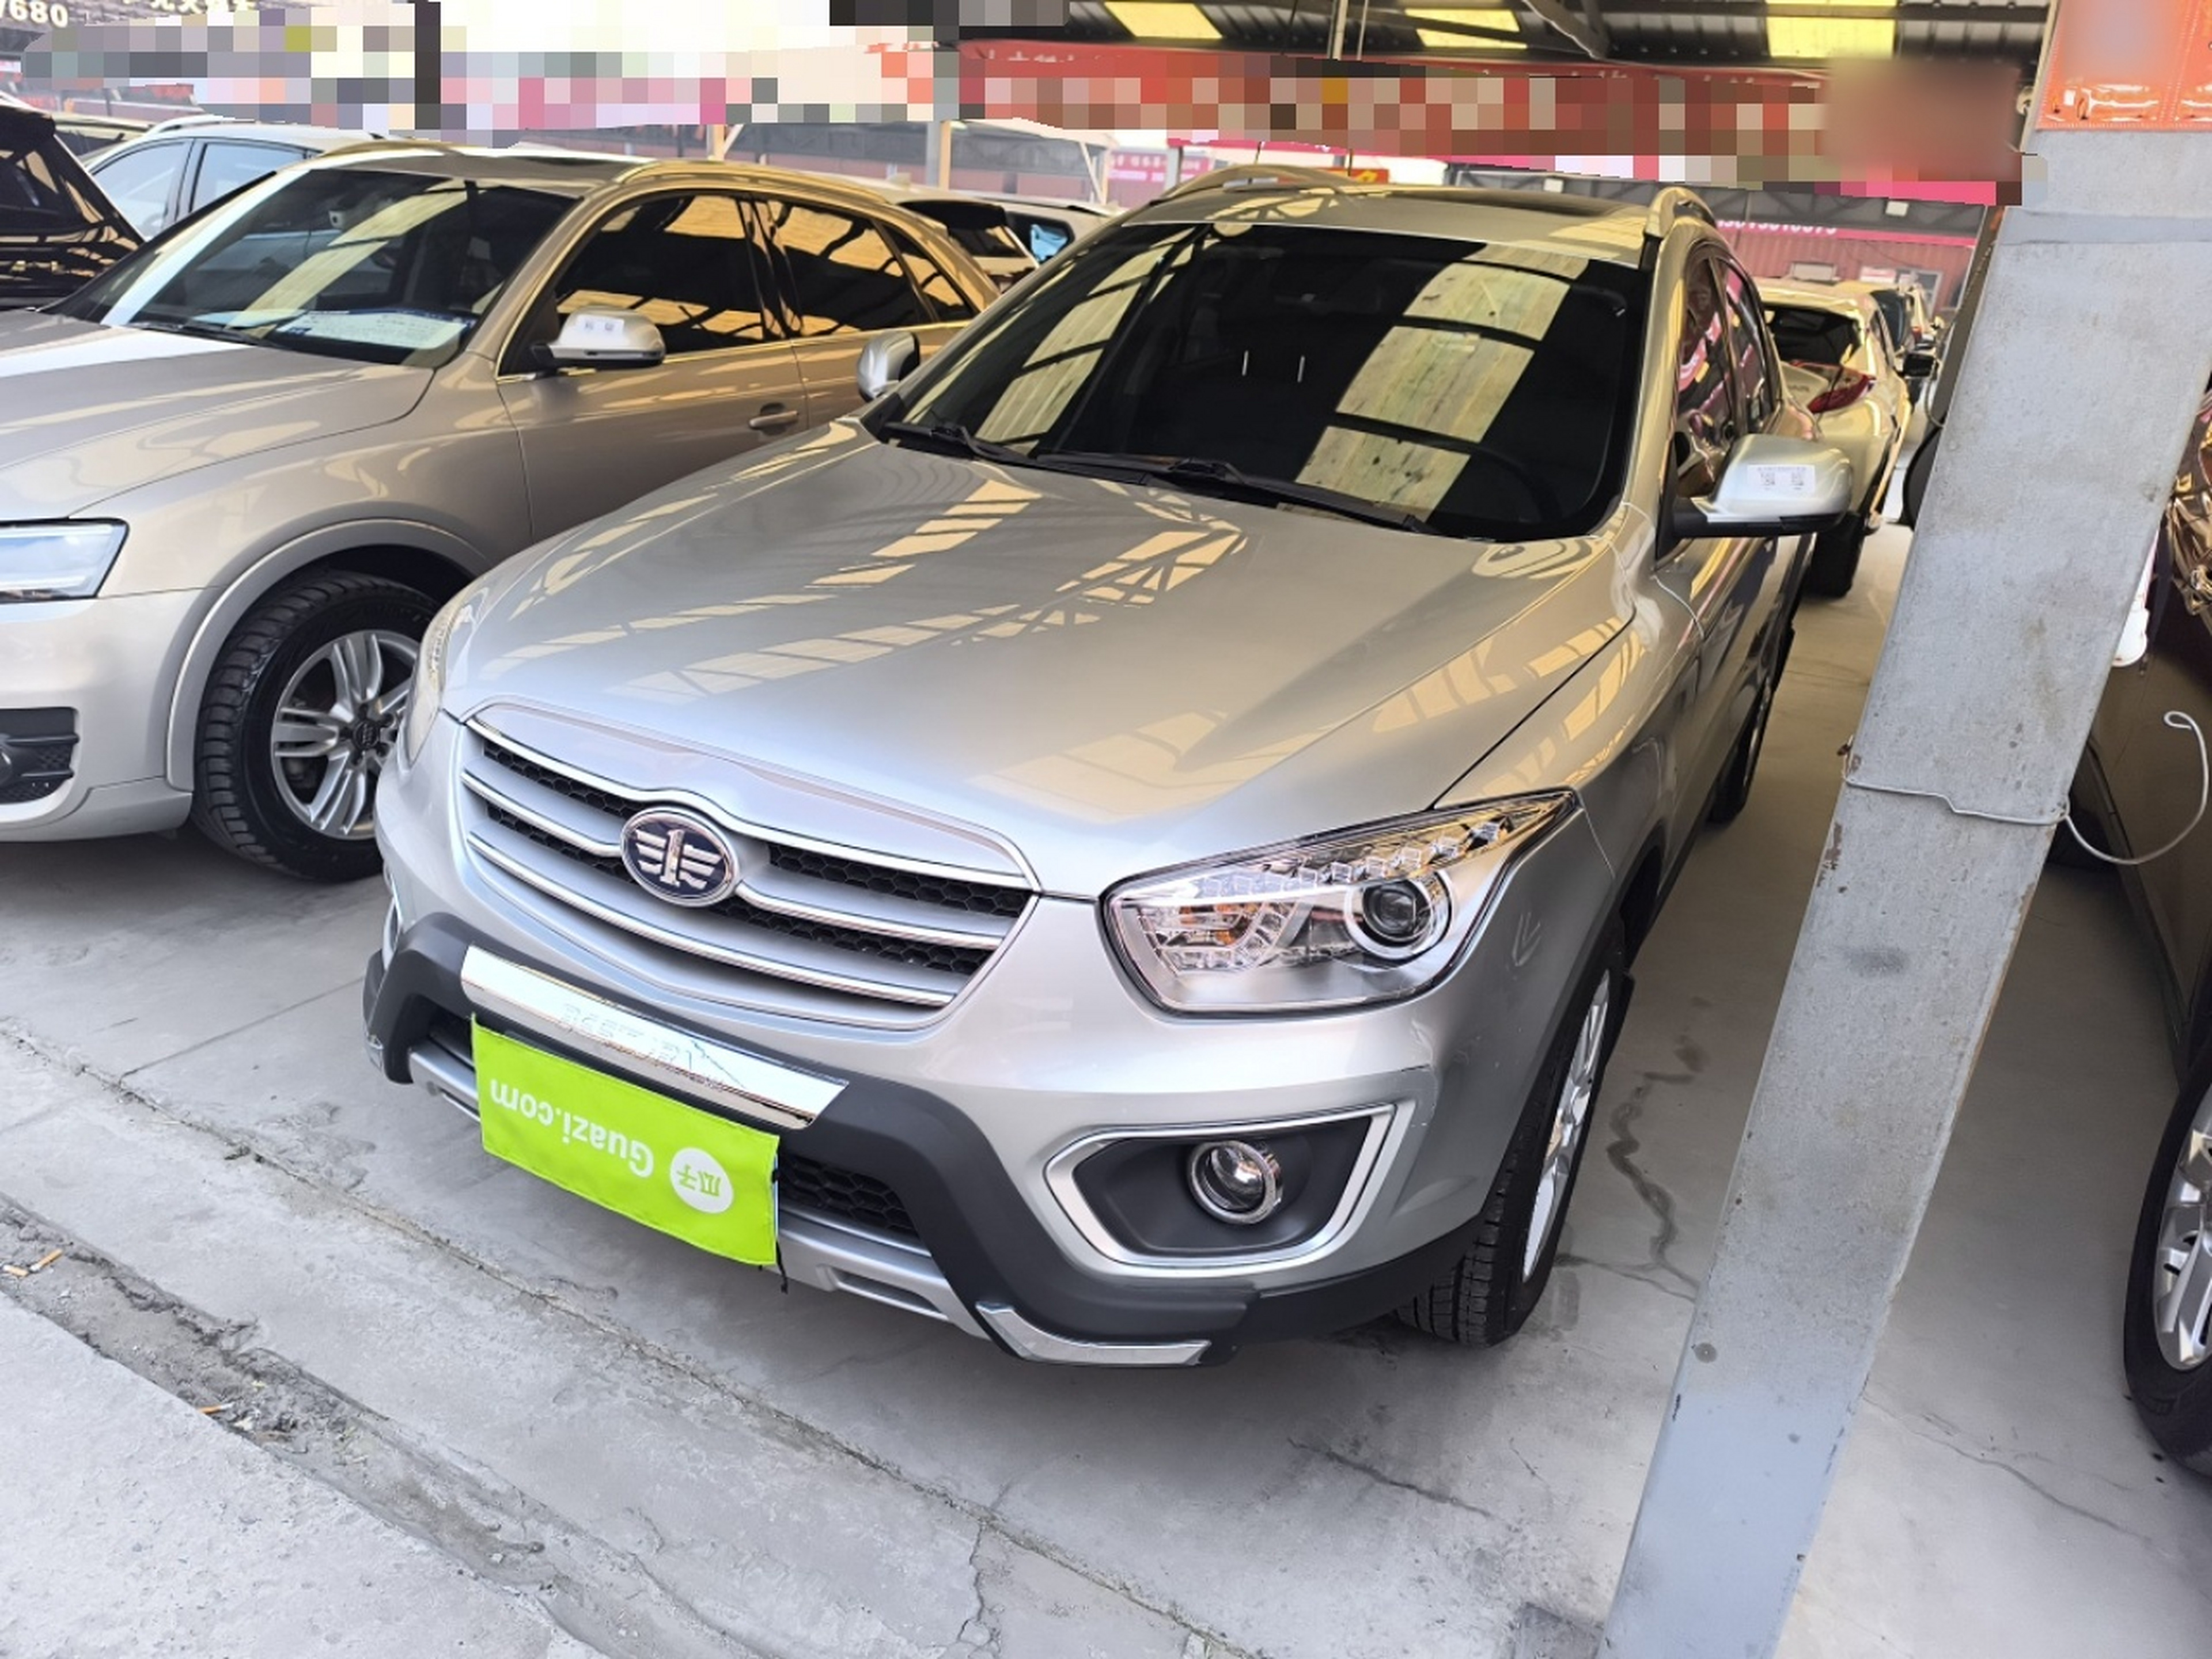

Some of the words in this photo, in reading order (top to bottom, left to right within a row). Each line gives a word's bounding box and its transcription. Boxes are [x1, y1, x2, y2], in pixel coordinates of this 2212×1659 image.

[0, 0, 68, 28] 680
[490, 1079, 654, 1178] Guazi.com
[676, 1164, 721, 1197] 瓜子
